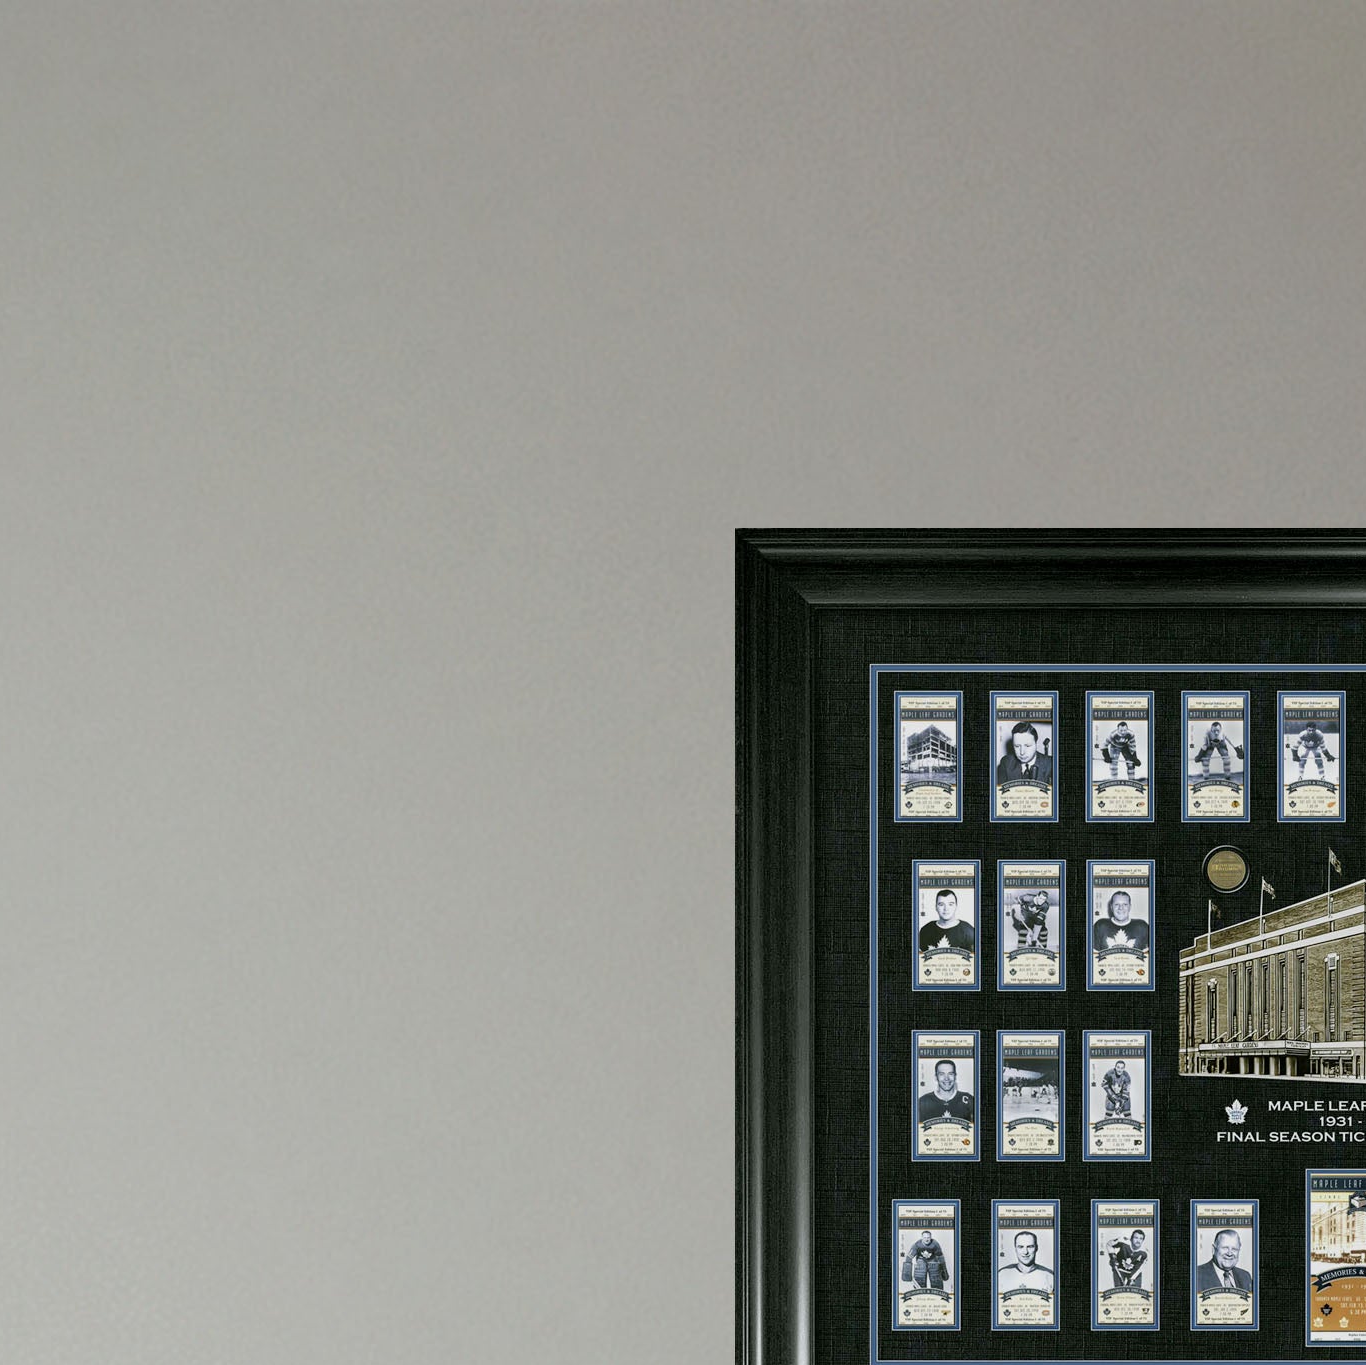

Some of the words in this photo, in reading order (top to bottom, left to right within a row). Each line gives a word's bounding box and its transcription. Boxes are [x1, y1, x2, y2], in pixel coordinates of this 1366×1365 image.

[1269, 1101, 1324, 1111] MAPLE
[1320, 1117, 1351, 1126] 1931
[1217, 1132, 1265, 1142] FINAL
[1270, 1132, 1335, 1142] SEASON
[1313, 1180, 1337, 1188] MAPLE
[1343, 1180, 1362, 1188] LEAF
[1321, 1268, 1356, 1281] MEMORIES
